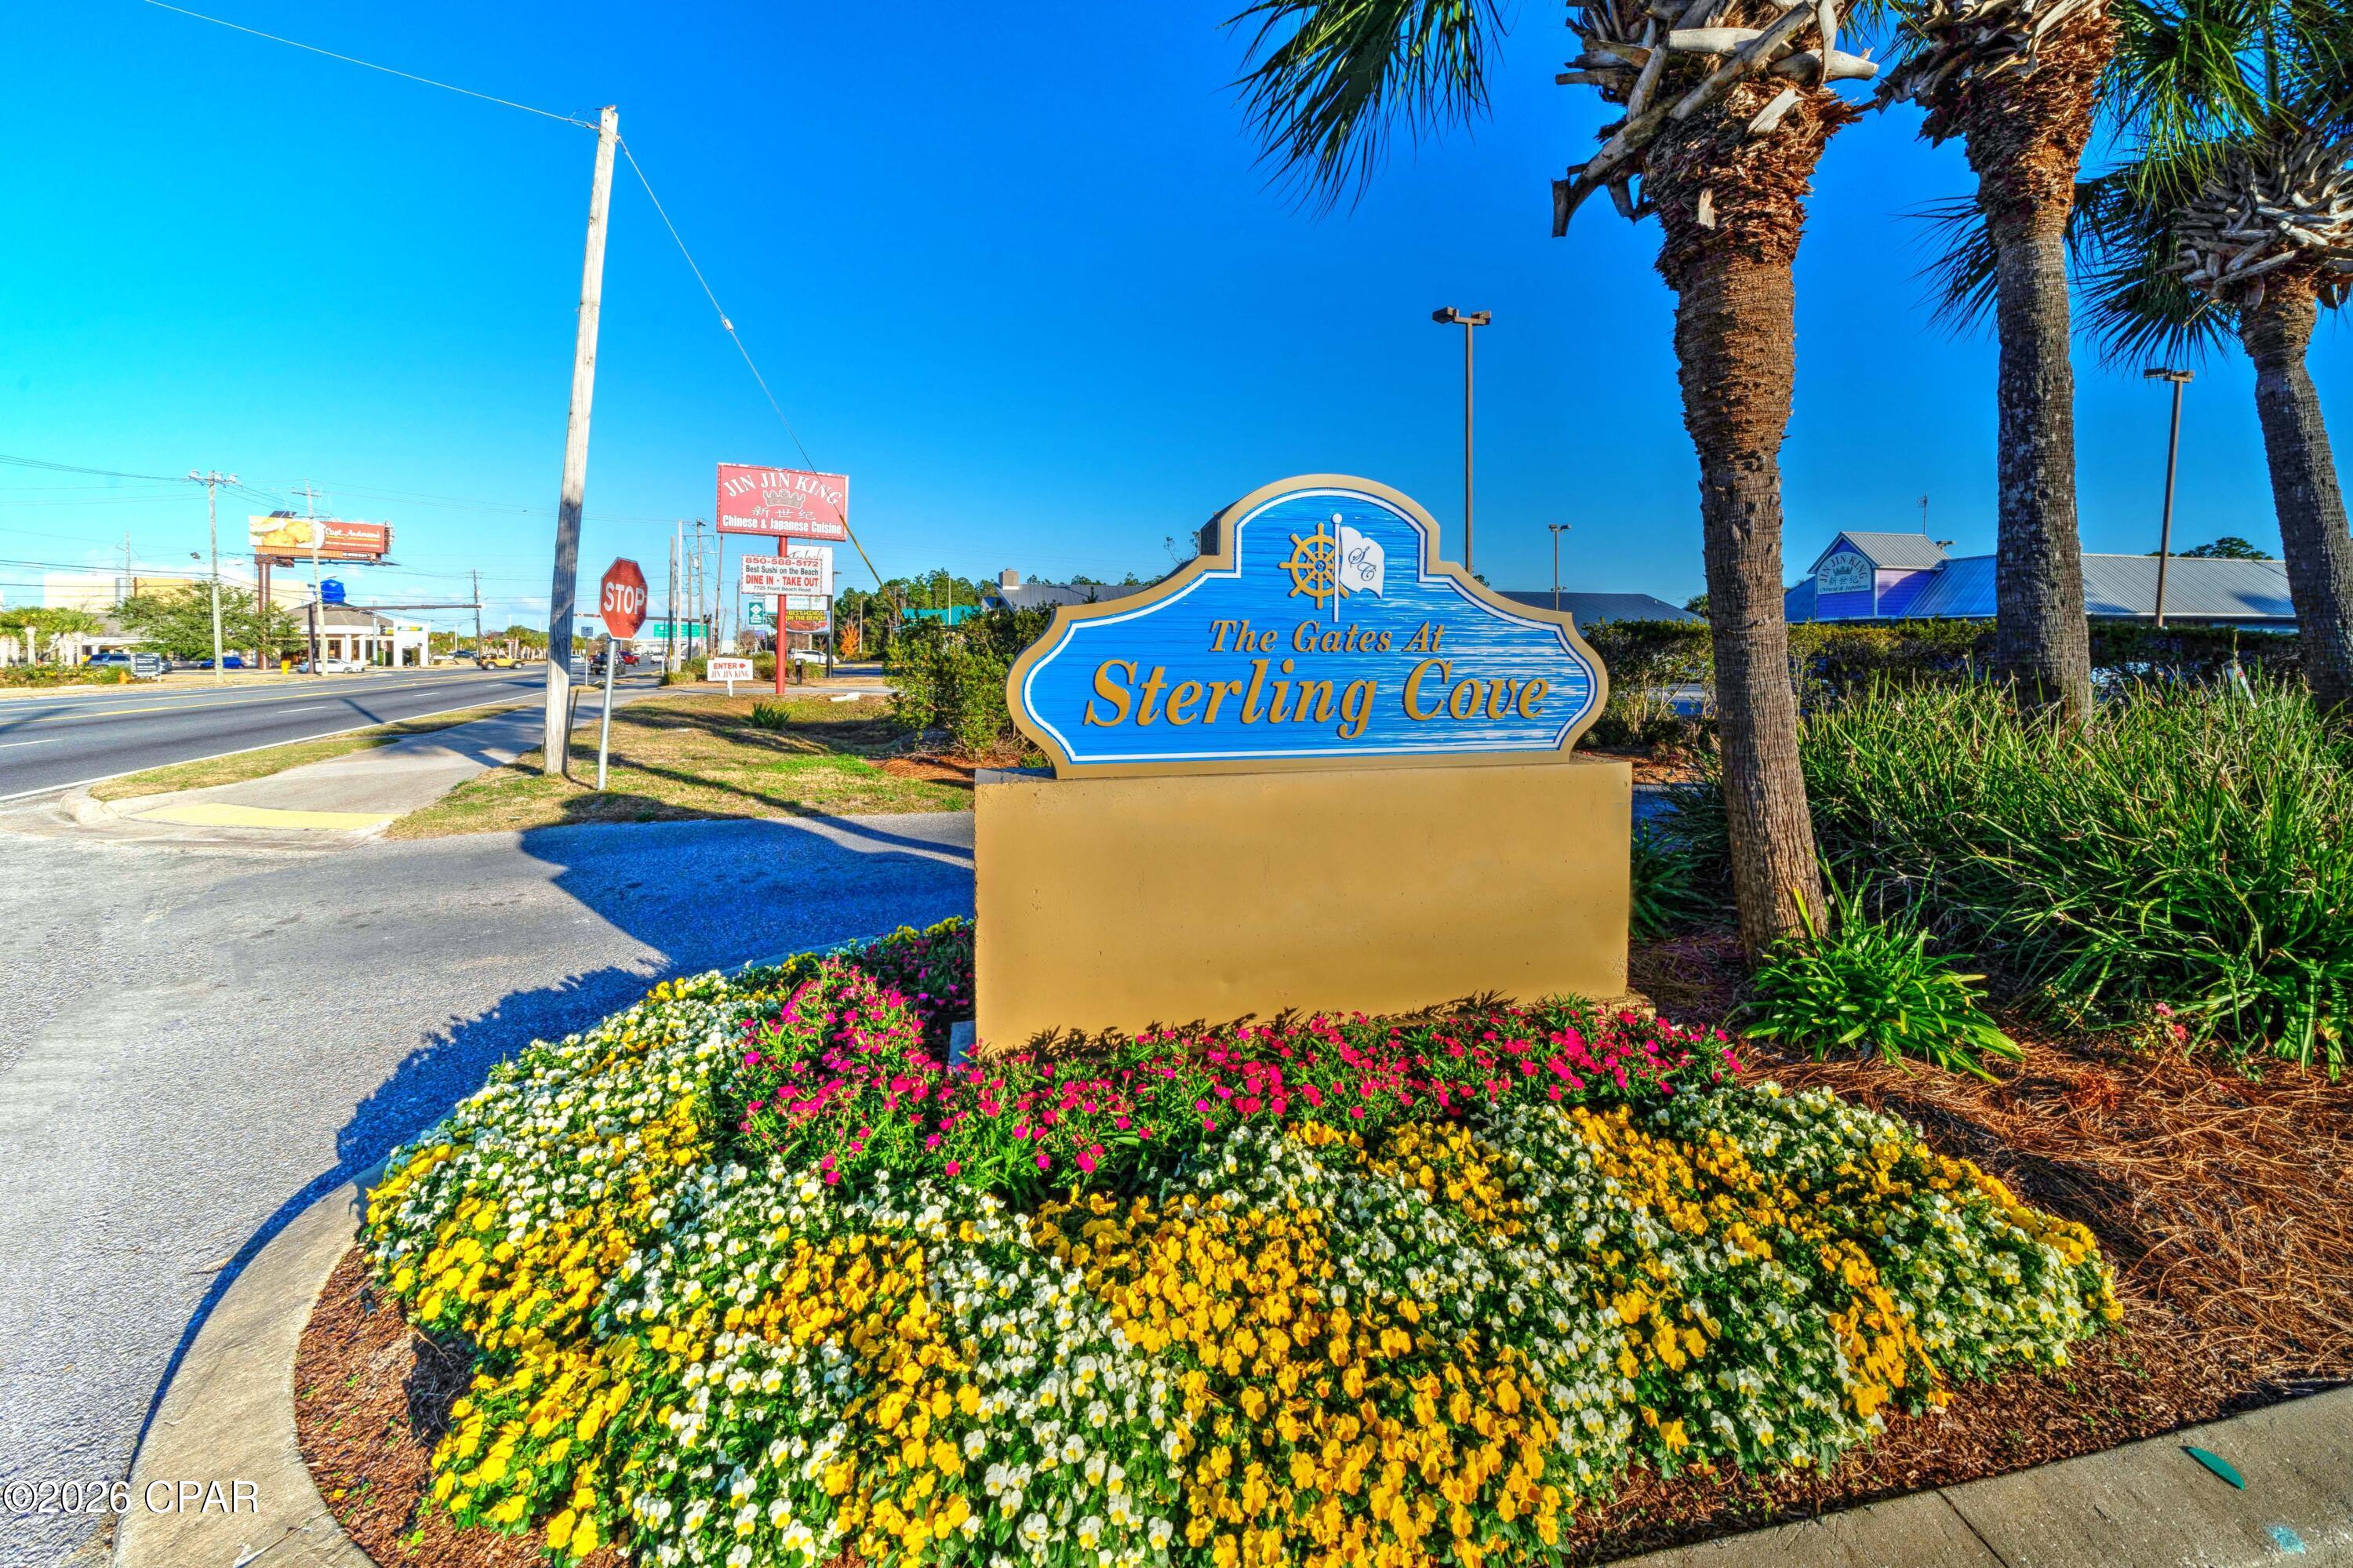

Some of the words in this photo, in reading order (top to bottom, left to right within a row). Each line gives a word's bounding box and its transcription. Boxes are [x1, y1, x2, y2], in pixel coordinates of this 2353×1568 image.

[723, 475, 756, 497] JIN
[761, 472, 790, 488] JIN
[795, 475, 842, 504] KING
[722, 515, 758, 528] Chinese
[761, 518, 767, 529] &
[769, 518, 809, 532] Japanese
[811, 521, 842, 534] Cuisine
[745, 557, 819, 567] 850-588-5172
[1820, 566, 1831, 583] JIN
[1831, 555, 1846, 567] JIN
[1849, 556, 1868, 579] KING
[746, 574, 764, 584] DINE
[766, 576, 773, 584] IN
[782, 577, 802, 586] TAKE
[804, 577, 819, 587] OUT
[603, 581, 645, 615] STOP
[1209, 620, 1278, 653] The
[1293, 620, 1393, 653] Gates
[1402, 621, 1445, 653] At
[1082, 658, 1378, 740] Sterling
[1402, 657, 1550, 721] Cove
